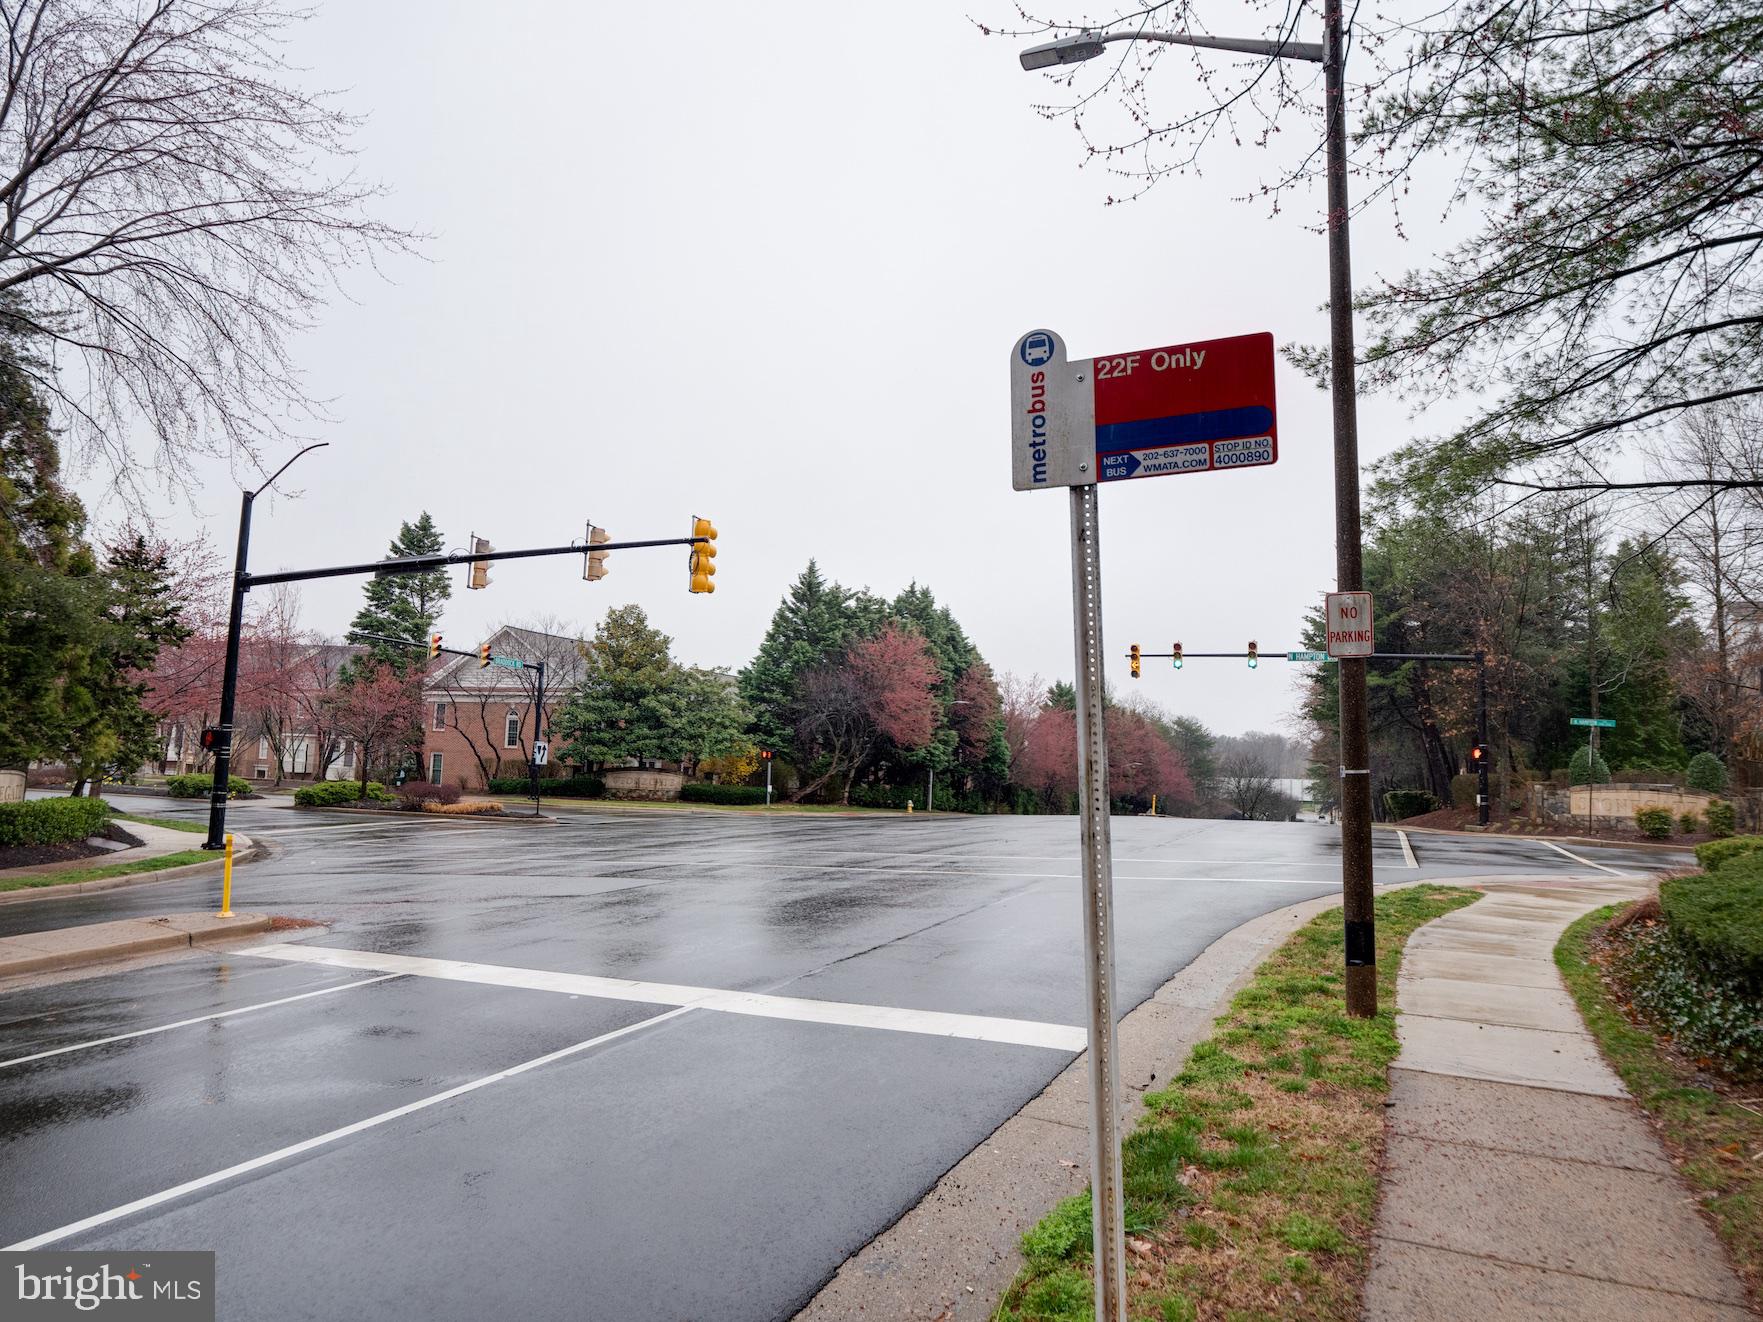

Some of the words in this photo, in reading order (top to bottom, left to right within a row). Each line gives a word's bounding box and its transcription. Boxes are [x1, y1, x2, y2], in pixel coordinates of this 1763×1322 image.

[1097, 355, 1140, 379] 22F
[1150, 348, 1206, 371] Only
[1027, 371, 1047, 483] metrobus
[1142, 446, 1207, 461] 202-637-7000
[1214, 442, 1240, 453] STOP
[1242, 441, 1251, 451] ID
[1103, 454, 1129, 466] NEXT
[1215, 449, 1270, 465] 4000890
[1106, 466, 1127, 478] BUS
[1143, 458, 1207, 473] WMATA.COM
[1340, 606, 1358, 619] NO
[1330, 630, 1370, 643] PARKING
[1296, 652, 1325, 661] HAMPTON
